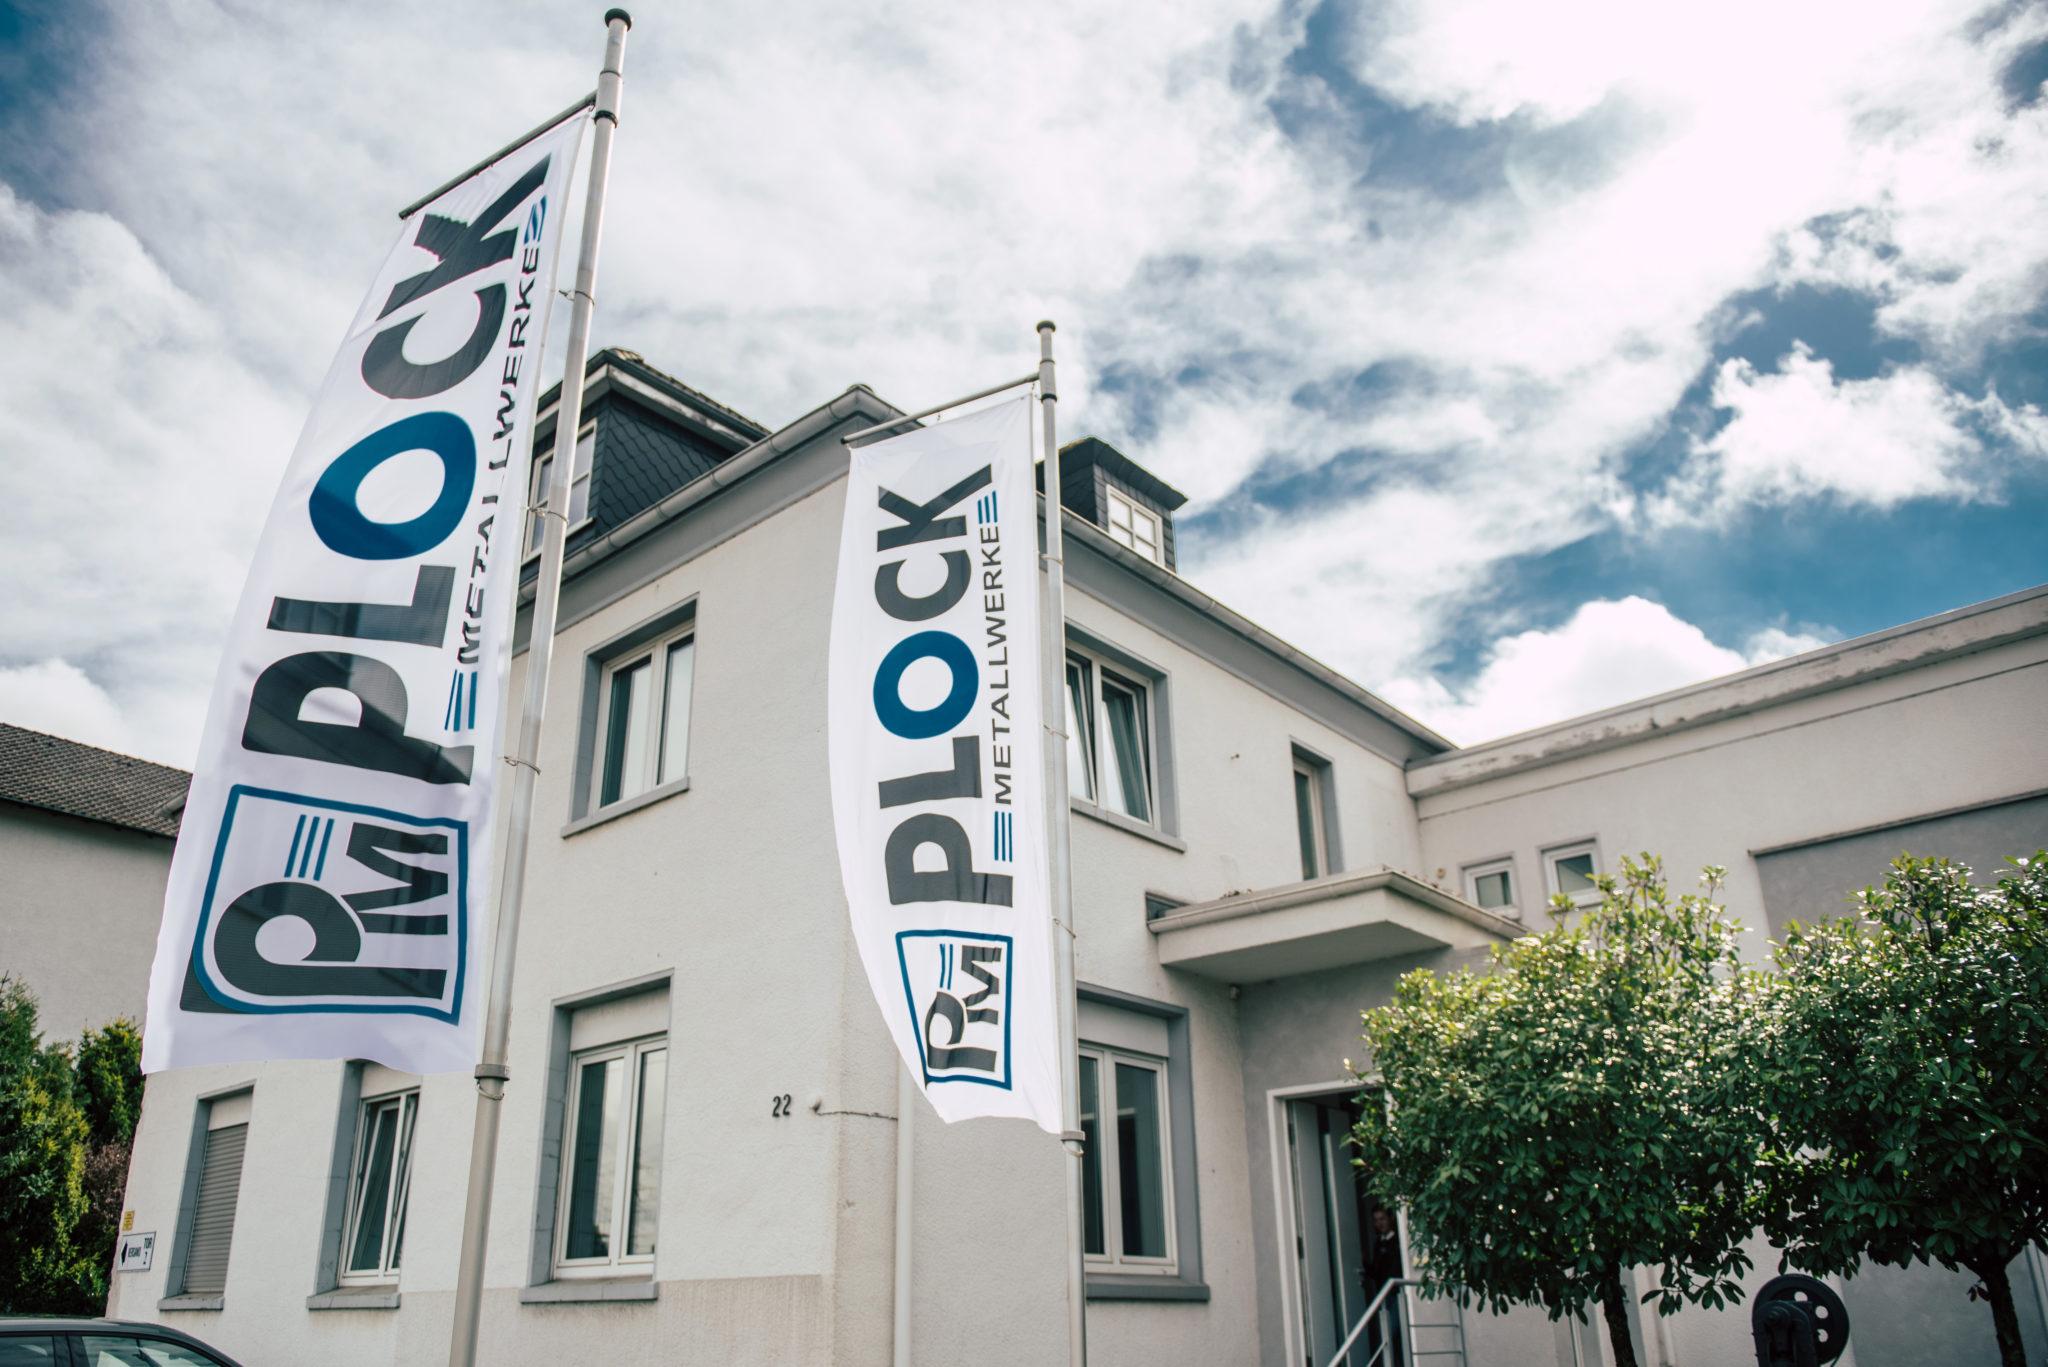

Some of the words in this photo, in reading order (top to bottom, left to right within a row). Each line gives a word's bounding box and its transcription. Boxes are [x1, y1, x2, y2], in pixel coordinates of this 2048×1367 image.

[241, 152, 552, 786] PLOCK
[873, 463, 1013, 908] PLOCK
[980, 525, 1012, 806] METALLWERKE
[772, 1094, 791, 1118] 22
